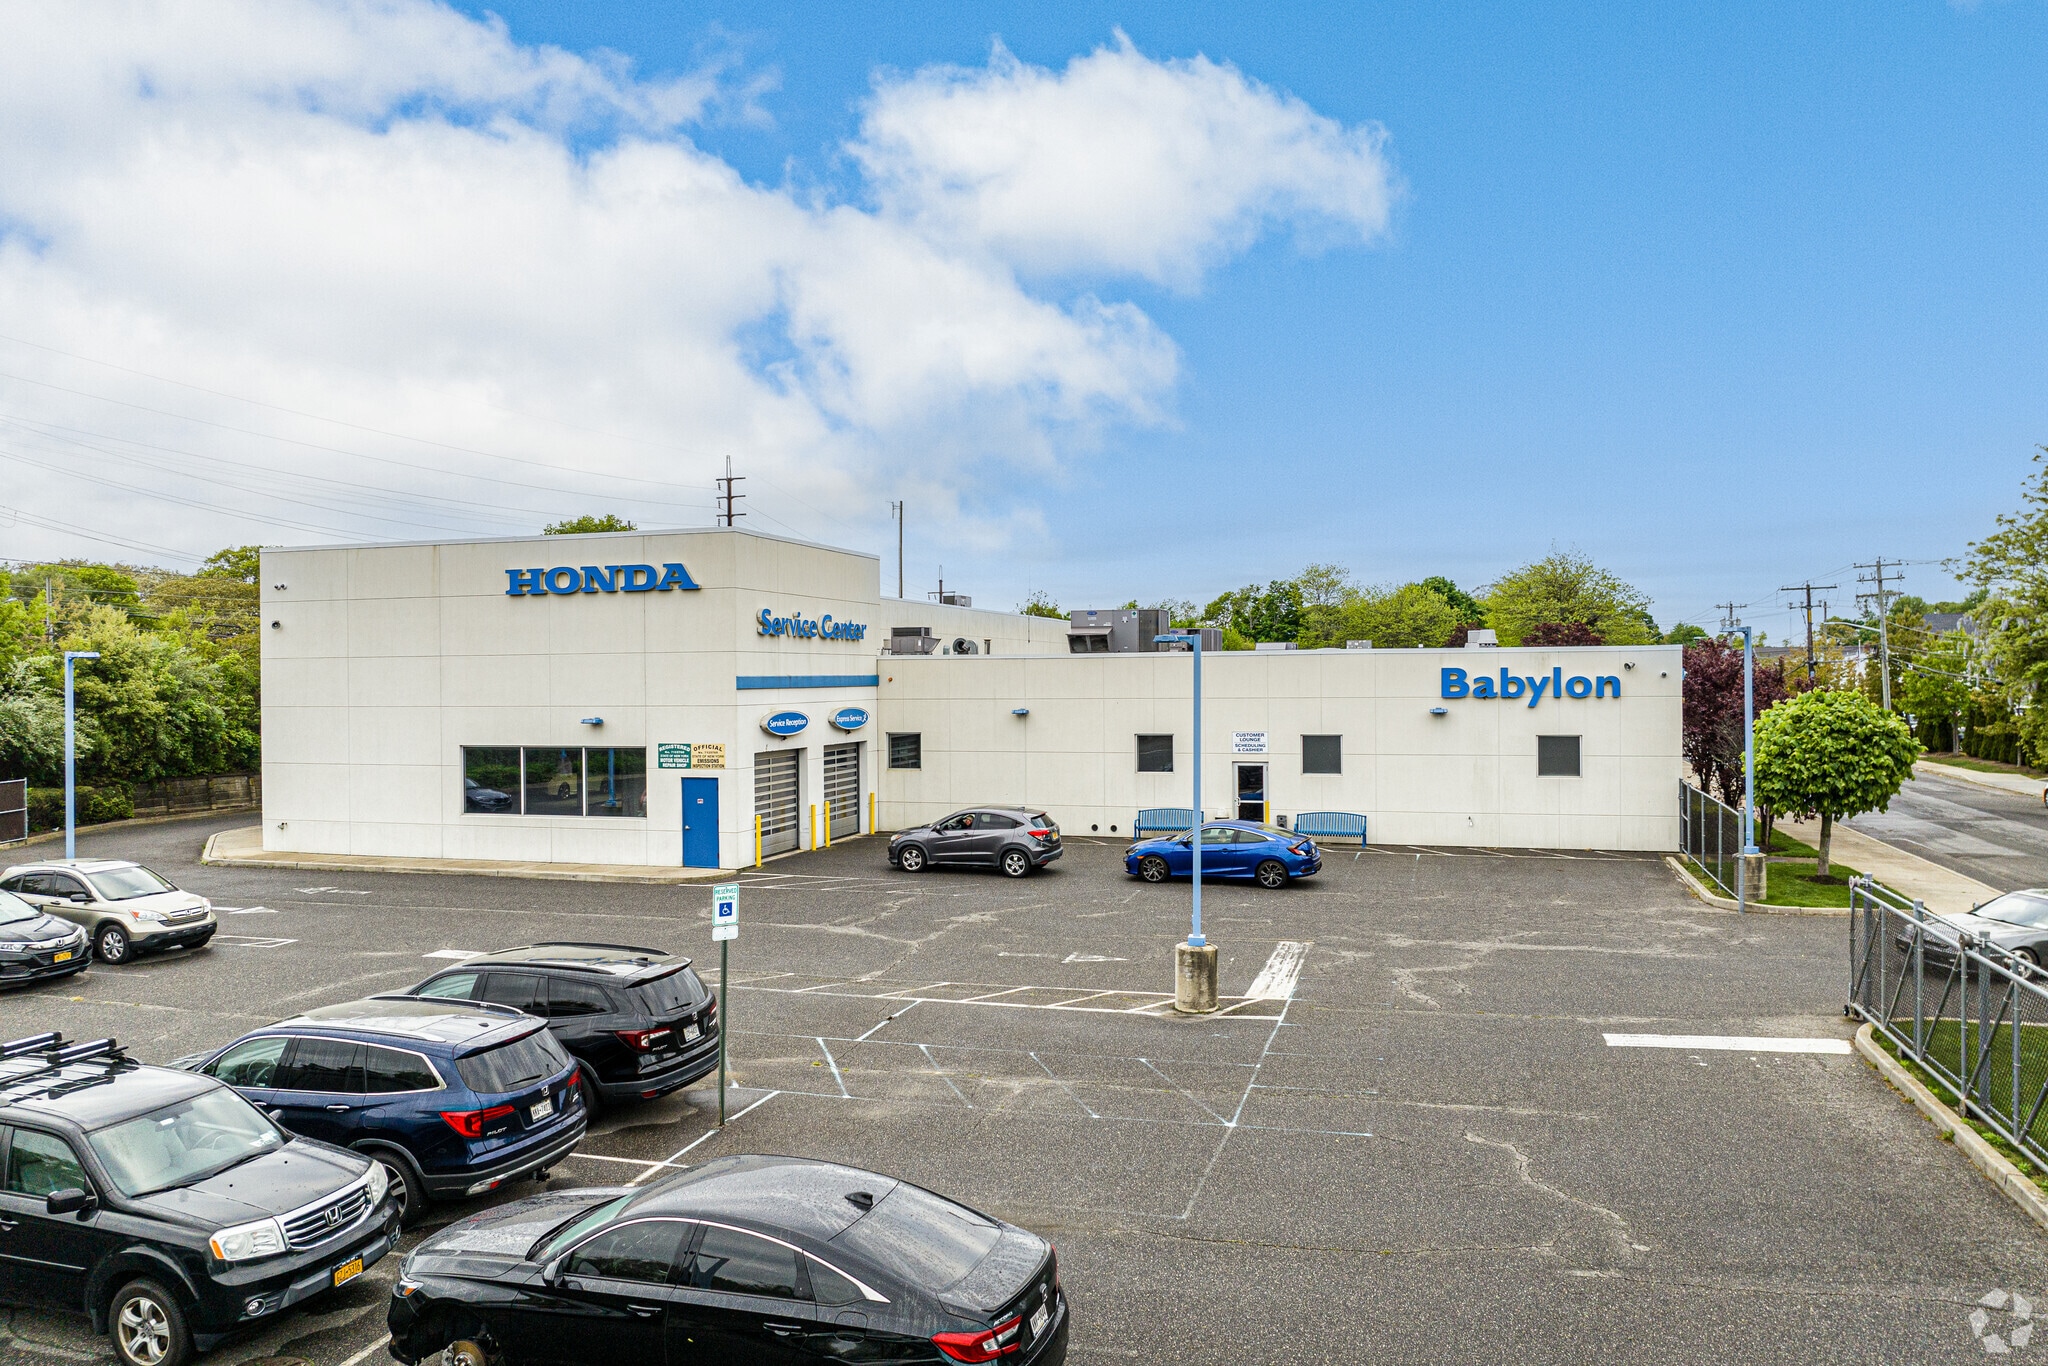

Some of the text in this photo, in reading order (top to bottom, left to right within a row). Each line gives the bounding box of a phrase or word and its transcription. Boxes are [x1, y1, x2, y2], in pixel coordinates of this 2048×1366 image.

[505, 563, 701, 595] HONDA
[759, 608, 867, 640] Service Center
[1440, 666, 1621, 708] Babylon
[850, 714, 862, 722] Service
[769, 718, 806, 728] Service Reception
[659, 744, 690, 752] REGISTERED
[693, 744, 722, 752] OFFICIAL
[486, 1127, 508, 1136] PILOT
